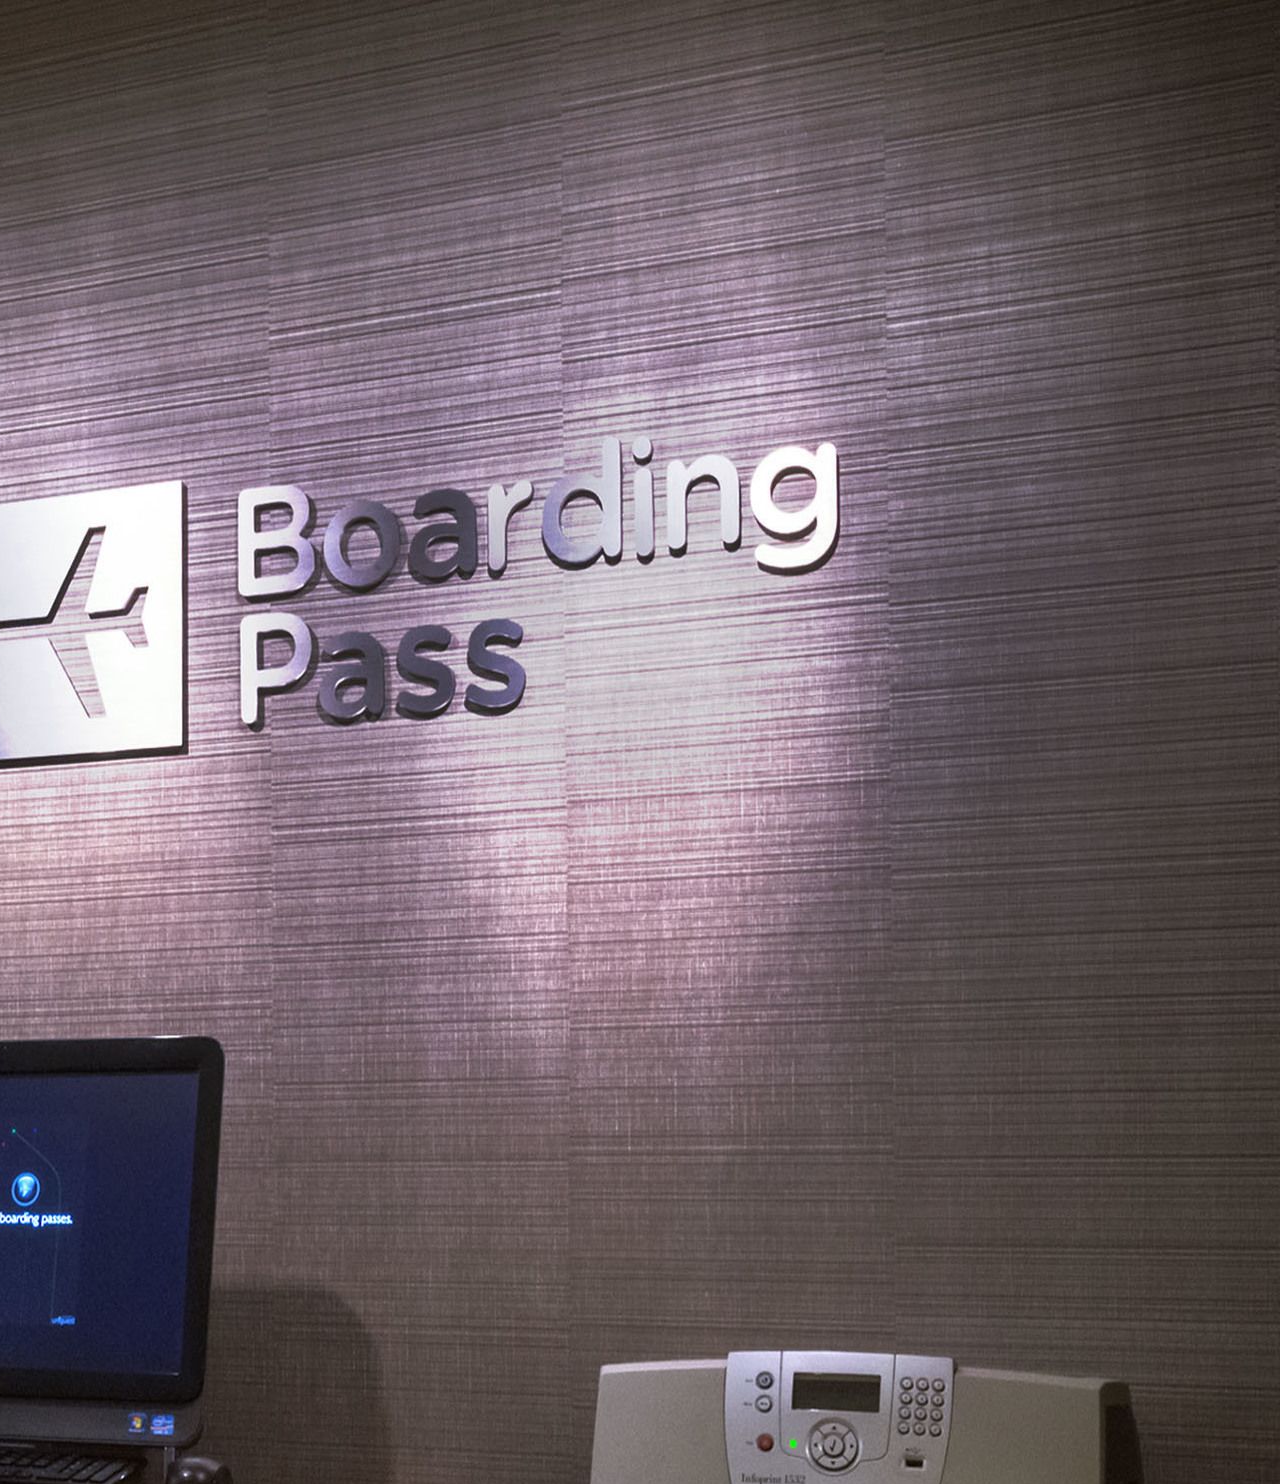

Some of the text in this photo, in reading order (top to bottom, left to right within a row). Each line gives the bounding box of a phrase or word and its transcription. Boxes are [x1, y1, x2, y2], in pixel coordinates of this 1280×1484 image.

[238, 434, 838, 598] Boarding
[241, 611, 527, 728] Pass
[0, 1210, 40, 1228] boarding
[41, 1213, 73, 1227] passes.
